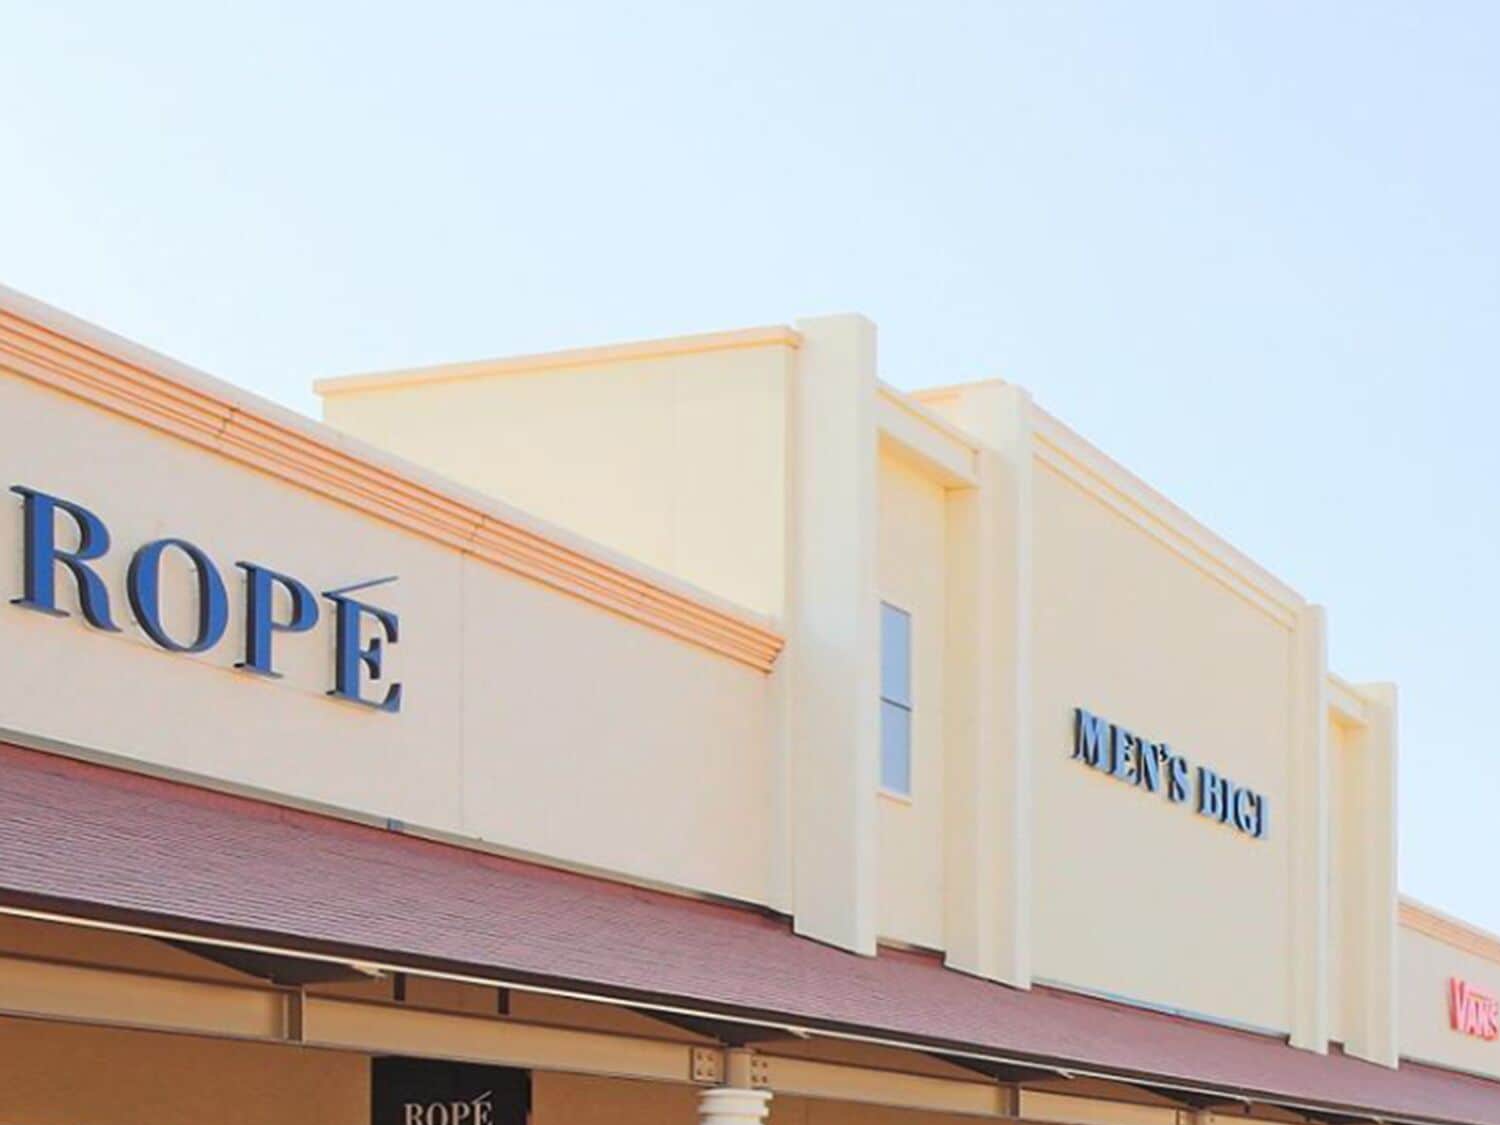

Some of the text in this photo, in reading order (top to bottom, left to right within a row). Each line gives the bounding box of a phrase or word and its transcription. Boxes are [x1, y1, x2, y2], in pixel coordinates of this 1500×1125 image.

[10, 485, 402, 713] ROPÉ
[1071, 707, 1192, 803] MEN'S
[1447, 976, 1500, 1042] VANS
